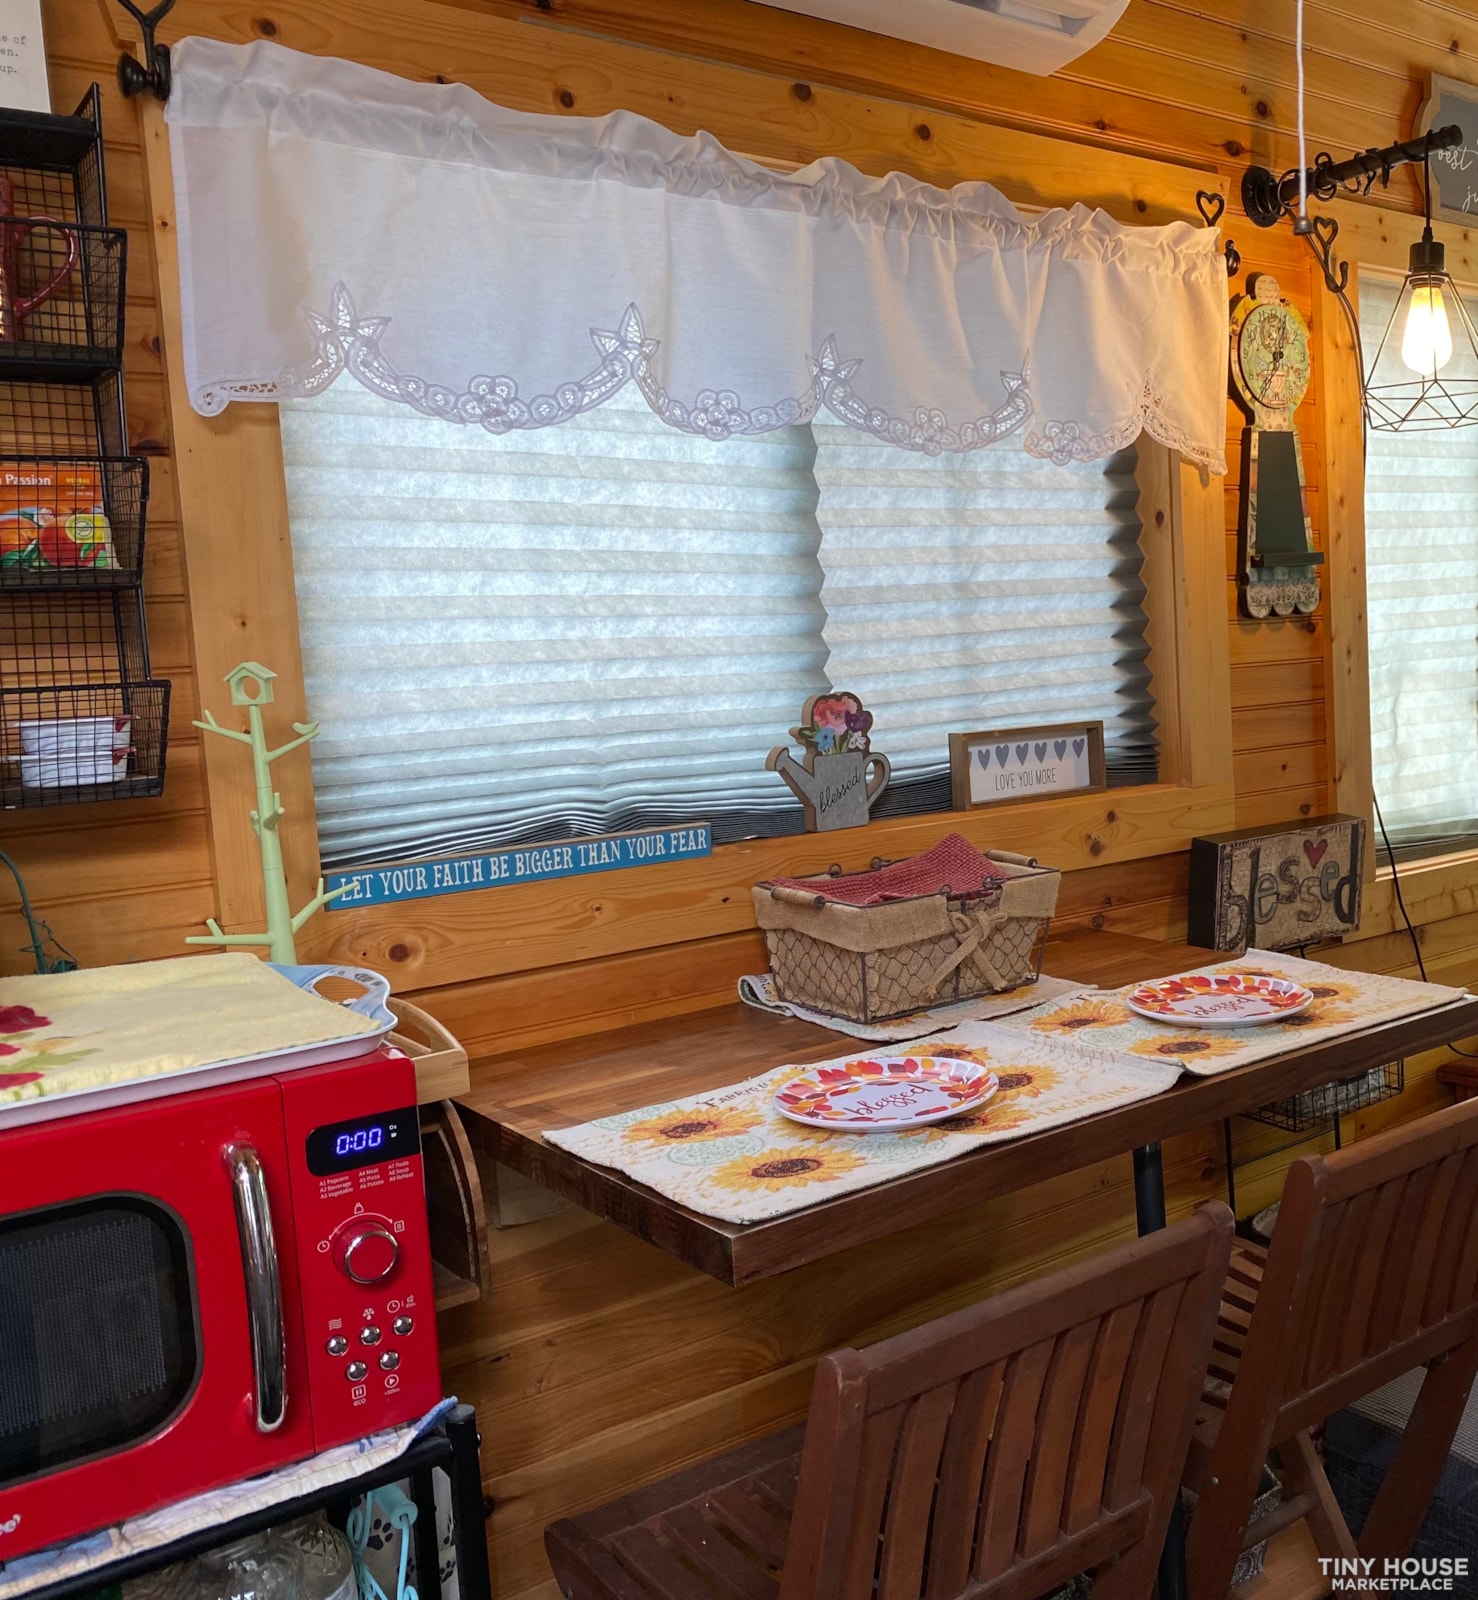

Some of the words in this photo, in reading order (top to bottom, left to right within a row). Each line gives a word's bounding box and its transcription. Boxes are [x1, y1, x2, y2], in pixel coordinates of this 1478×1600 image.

[13, 35, 27, 45] of
[1299, 351, 1306, 363] 3
[5, 473, 52, 486] Passion
[994, 772, 1015, 791] LOVE
[1018, 770, 1034, 788] YOU
[1035, 767, 1057, 785] MORE
[819, 766, 862, 815] blessed
[339, 874, 374, 902] LET
[378, 866, 429, 896] YOUR
[432, 858, 485, 889] FAITH
[489, 854, 511, 880] BE
[514, 847, 574, 877] BIGGER
[577, 839, 622, 868] THAN
[626, 833, 667, 860] YOUR
[670, 828, 708, 854] FEAR
[1216, 824, 1360, 951] blessed
[1184, 995, 1257, 1016] blessed
[842, 1083, 934, 1116] blessed
[336, 1127, 382, 1155] 0:00
[327, 1181, 352, 1192] Beverage
[366, 1173, 380, 1182] Pizza
